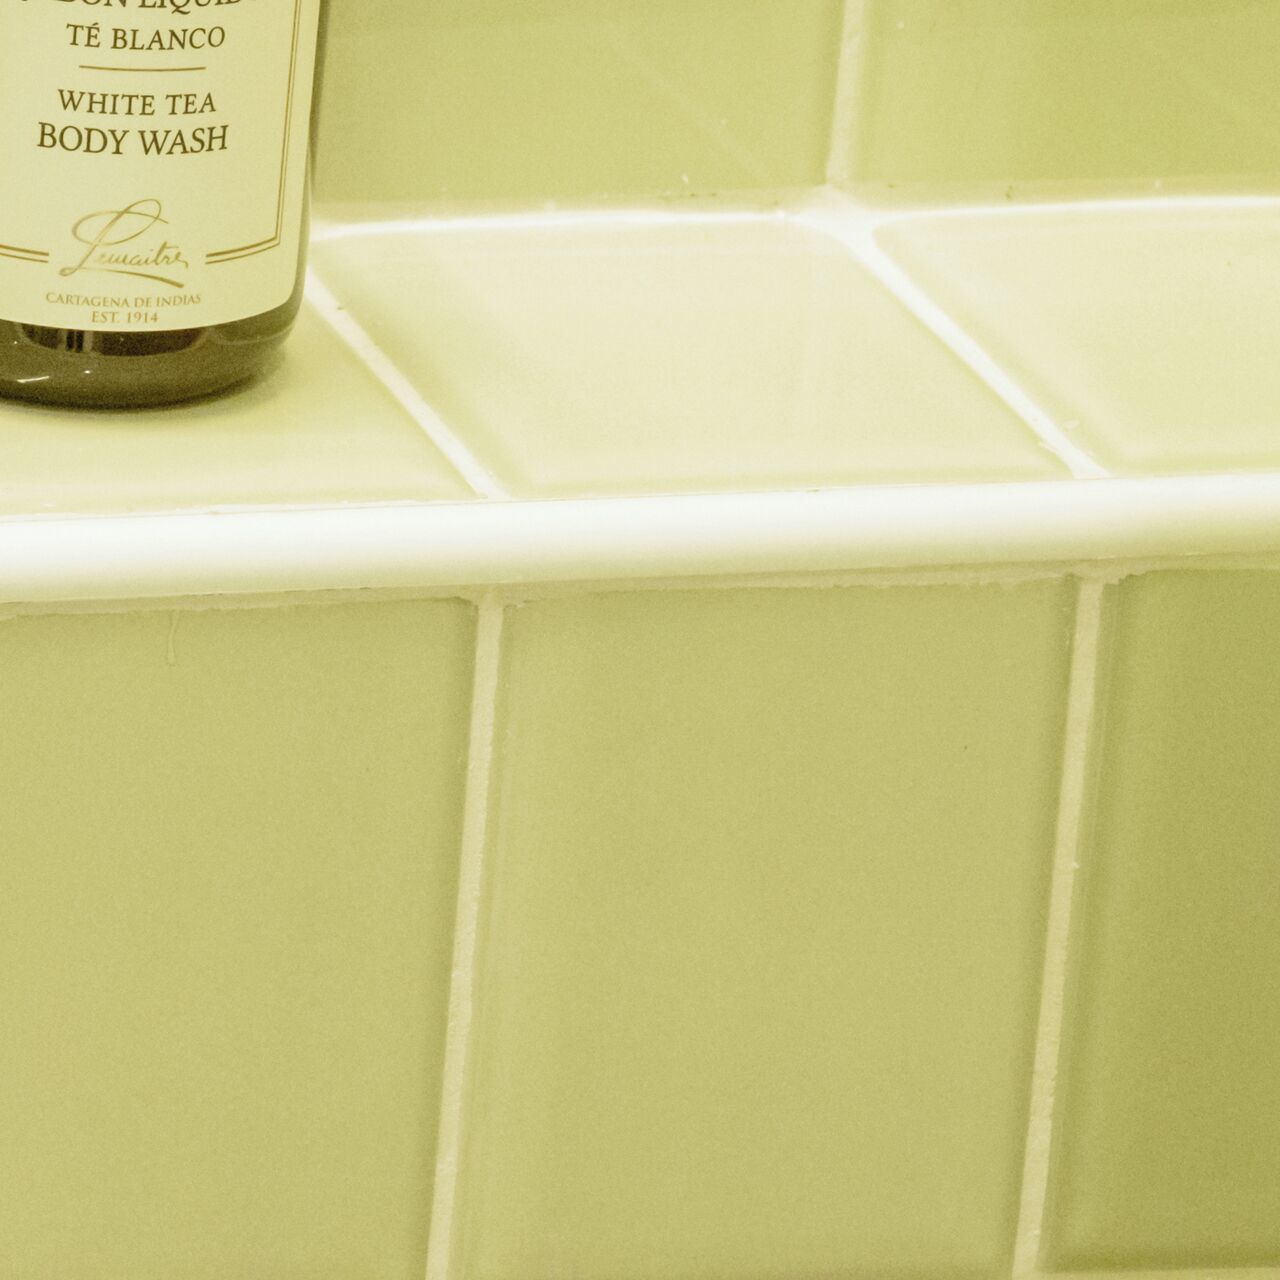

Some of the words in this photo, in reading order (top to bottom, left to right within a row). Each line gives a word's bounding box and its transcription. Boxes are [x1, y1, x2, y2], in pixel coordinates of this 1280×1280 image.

[66, 22, 102, 48] TÉ
[110, 26, 226, 51] BLANCO
[57, 88, 156, 116] WHITE
[165, 92, 217, 116] TEA
[36, 121, 130, 155] BODY
[138, 124, 230, 156] WASH
[45, 291, 130, 308] CARTAGENA
[133, 297, 153, 308] DE
[155, 293, 202, 307] INDIAS
[90, 310, 121, 323] EST.
[126, 311, 161, 323] 1914
